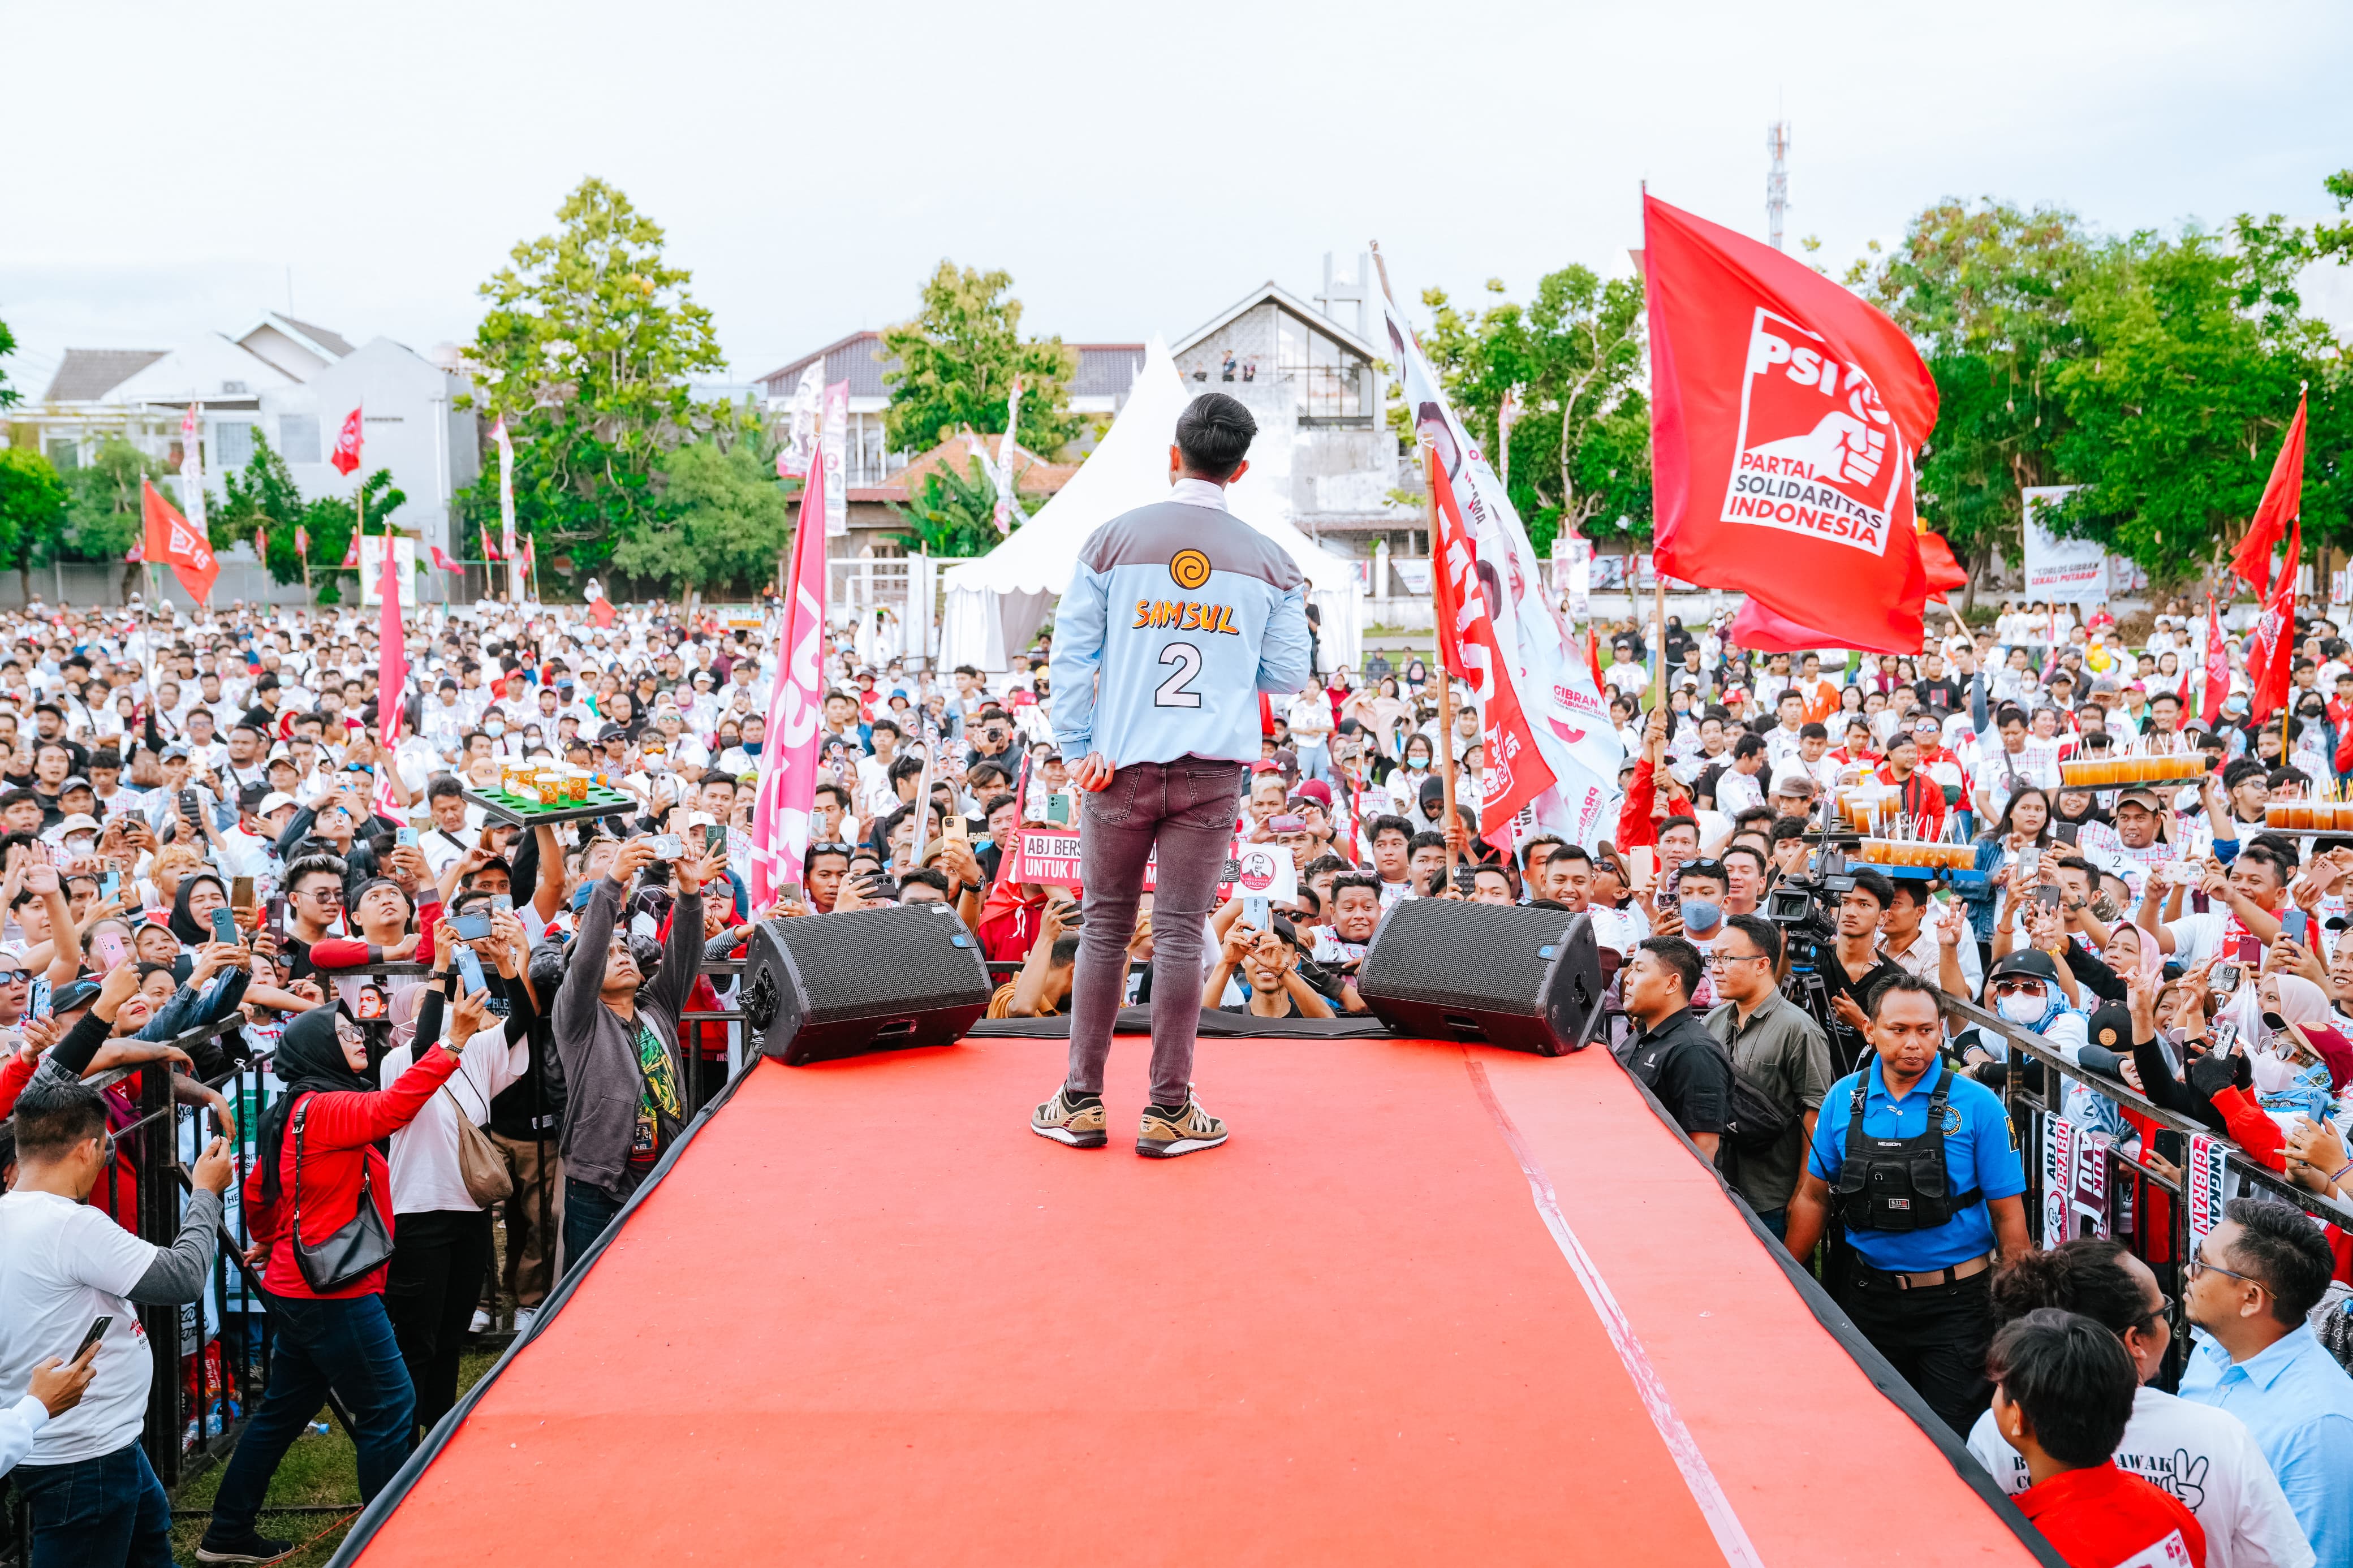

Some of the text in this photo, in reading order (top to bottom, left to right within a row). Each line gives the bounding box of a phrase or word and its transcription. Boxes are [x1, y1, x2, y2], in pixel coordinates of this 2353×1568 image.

[1753, 331, 1838, 397] PSI
[1740, 452, 1814, 480] PARTAI
[1735, 474, 1882, 529] SOLIDARITAS
[1729, 496, 1877, 547] INDONESIA
[193, 549, 210, 569] 15
[1132, 599, 1240, 636] SAMSUL
[1154, 642, 1203, 708] 2
[1554, 684, 1598, 708] GIBRAN
[1485, 727, 1502, 765] PSI
[1505, 730, 1521, 759] 15
[1033, 809, 1040, 818] 2
[1028, 838, 1049, 855] ABJ
[1025, 858, 1068, 879] UNTUK
[2112, 856, 2121, 867] 2
[2047, 1142, 2056, 1182] ABJ
